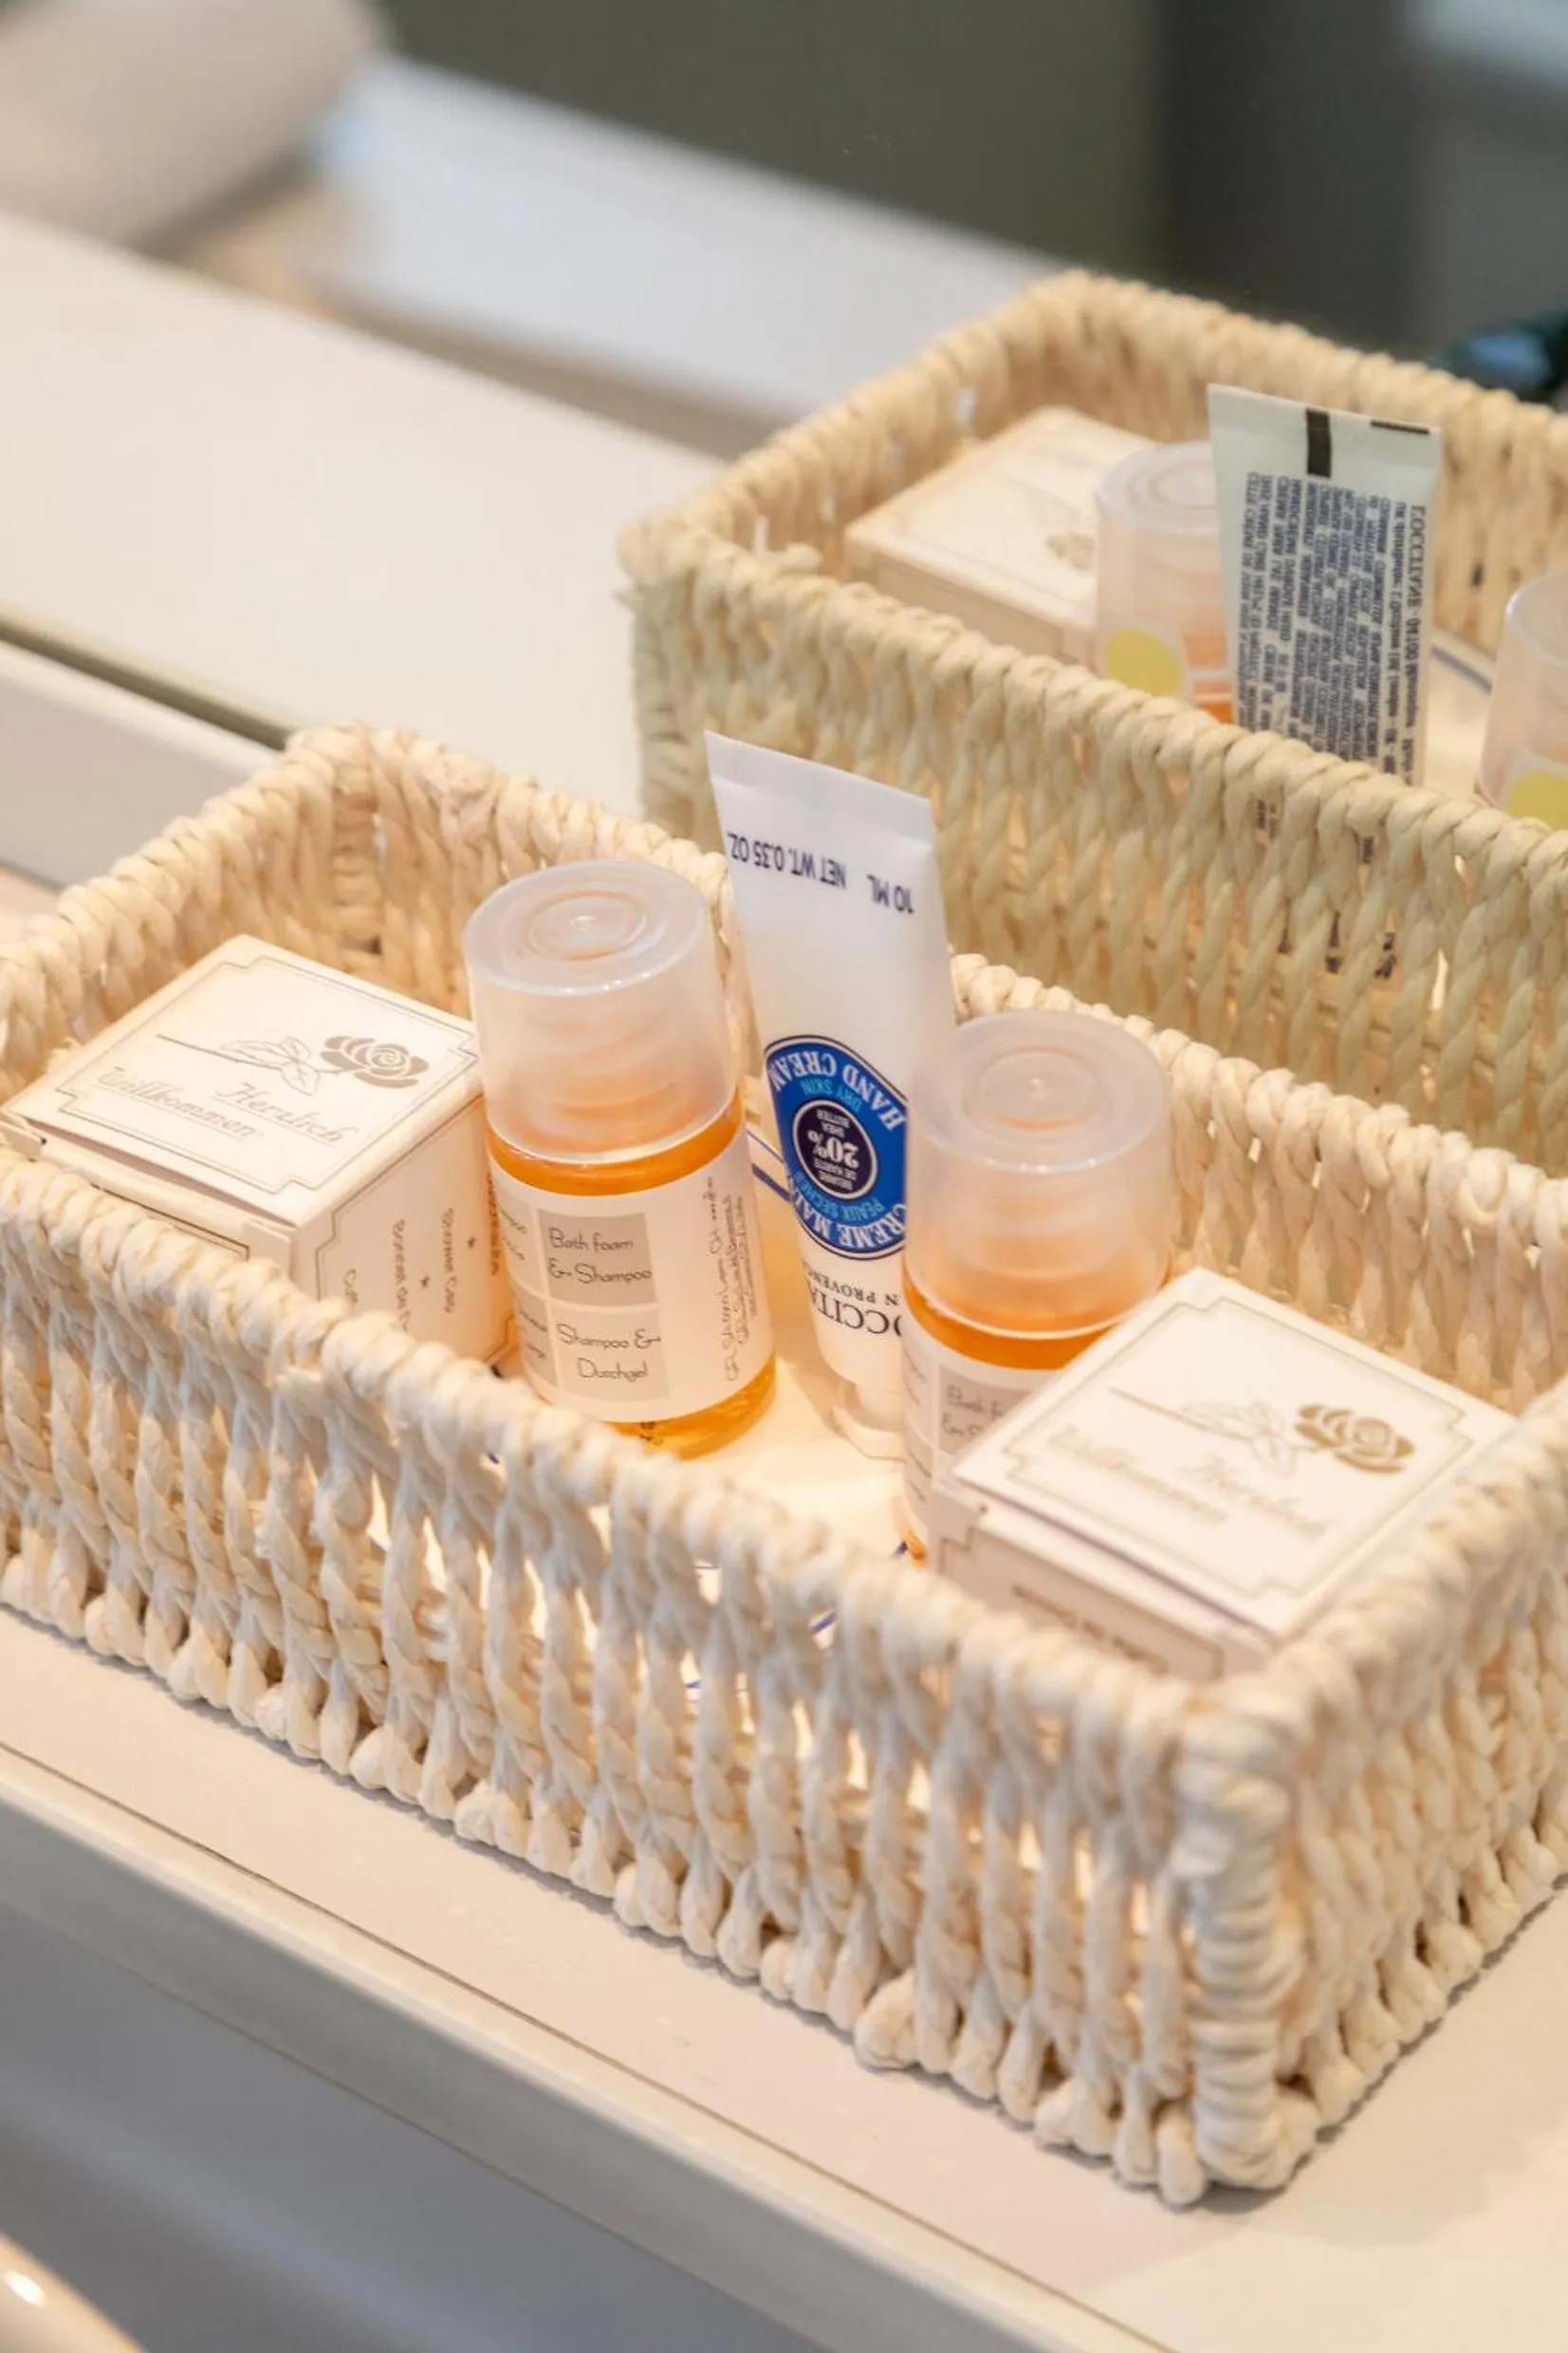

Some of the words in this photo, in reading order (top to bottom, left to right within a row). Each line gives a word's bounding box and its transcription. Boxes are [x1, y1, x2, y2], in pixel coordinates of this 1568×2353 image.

[727, 831, 750, 862] OZ
[753, 841, 784, 871] 0.35
[821, 858, 846, 889] NET
[867, 874, 890, 908] ML
[894, 885, 914, 914] 10
[766, 1049, 837, 1091] CREAM
[801, 1079, 833, 1096] SKIN
[837, 1085, 863, 1114] DRY
[842, 1064, 908, 1131] HAND
[806, 1129, 860, 1169] 20%
[547, 1227, 588, 1251] Bath
[575, 1263, 653, 1285] Shampoo
[556, 1324, 629, 1349] Shampoo
[577, 1357, 649, 1382] Duschgel
